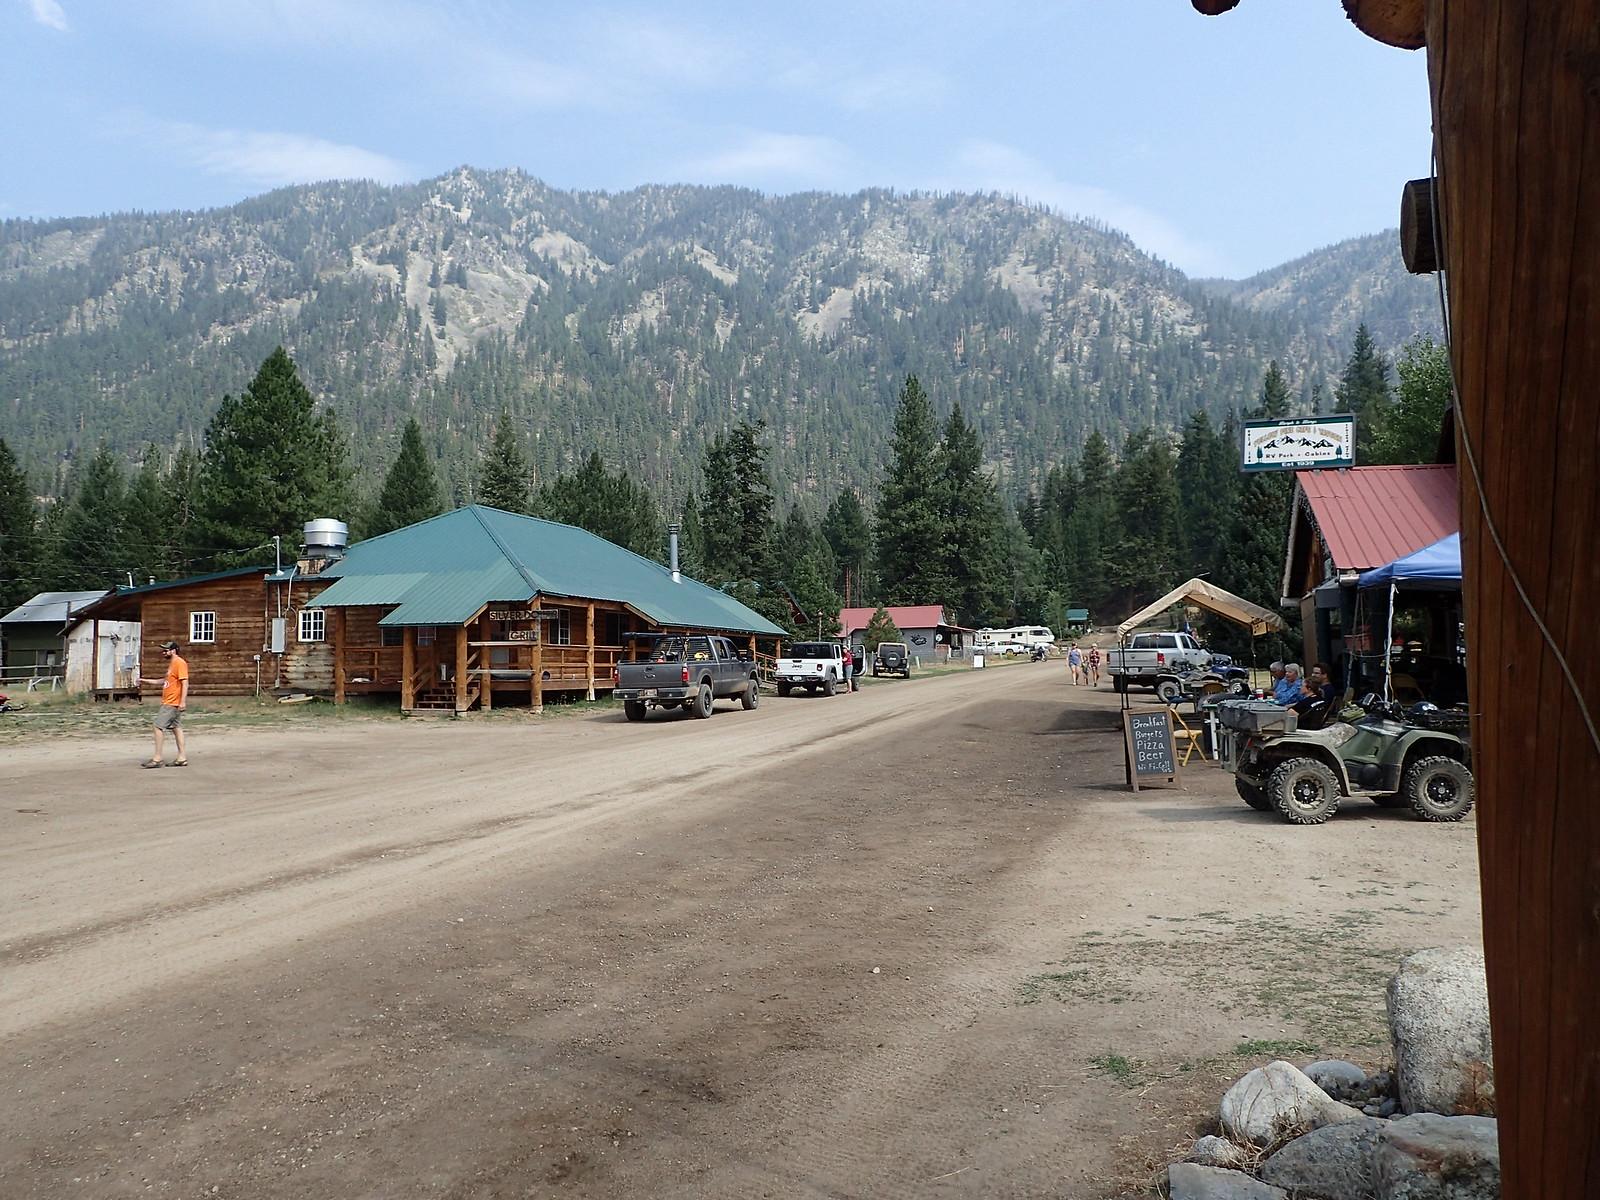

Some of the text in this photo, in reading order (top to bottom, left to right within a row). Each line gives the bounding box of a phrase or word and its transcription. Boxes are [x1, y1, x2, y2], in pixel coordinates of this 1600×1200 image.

[490, 611, 522, 620] SILVER
[1132, 715, 1166, 729] Breakfast
[1135, 730, 1163, 740] Burgers
[1136, 740, 1165, 750] Pizza
[1138, 751, 1165, 761] Beer
